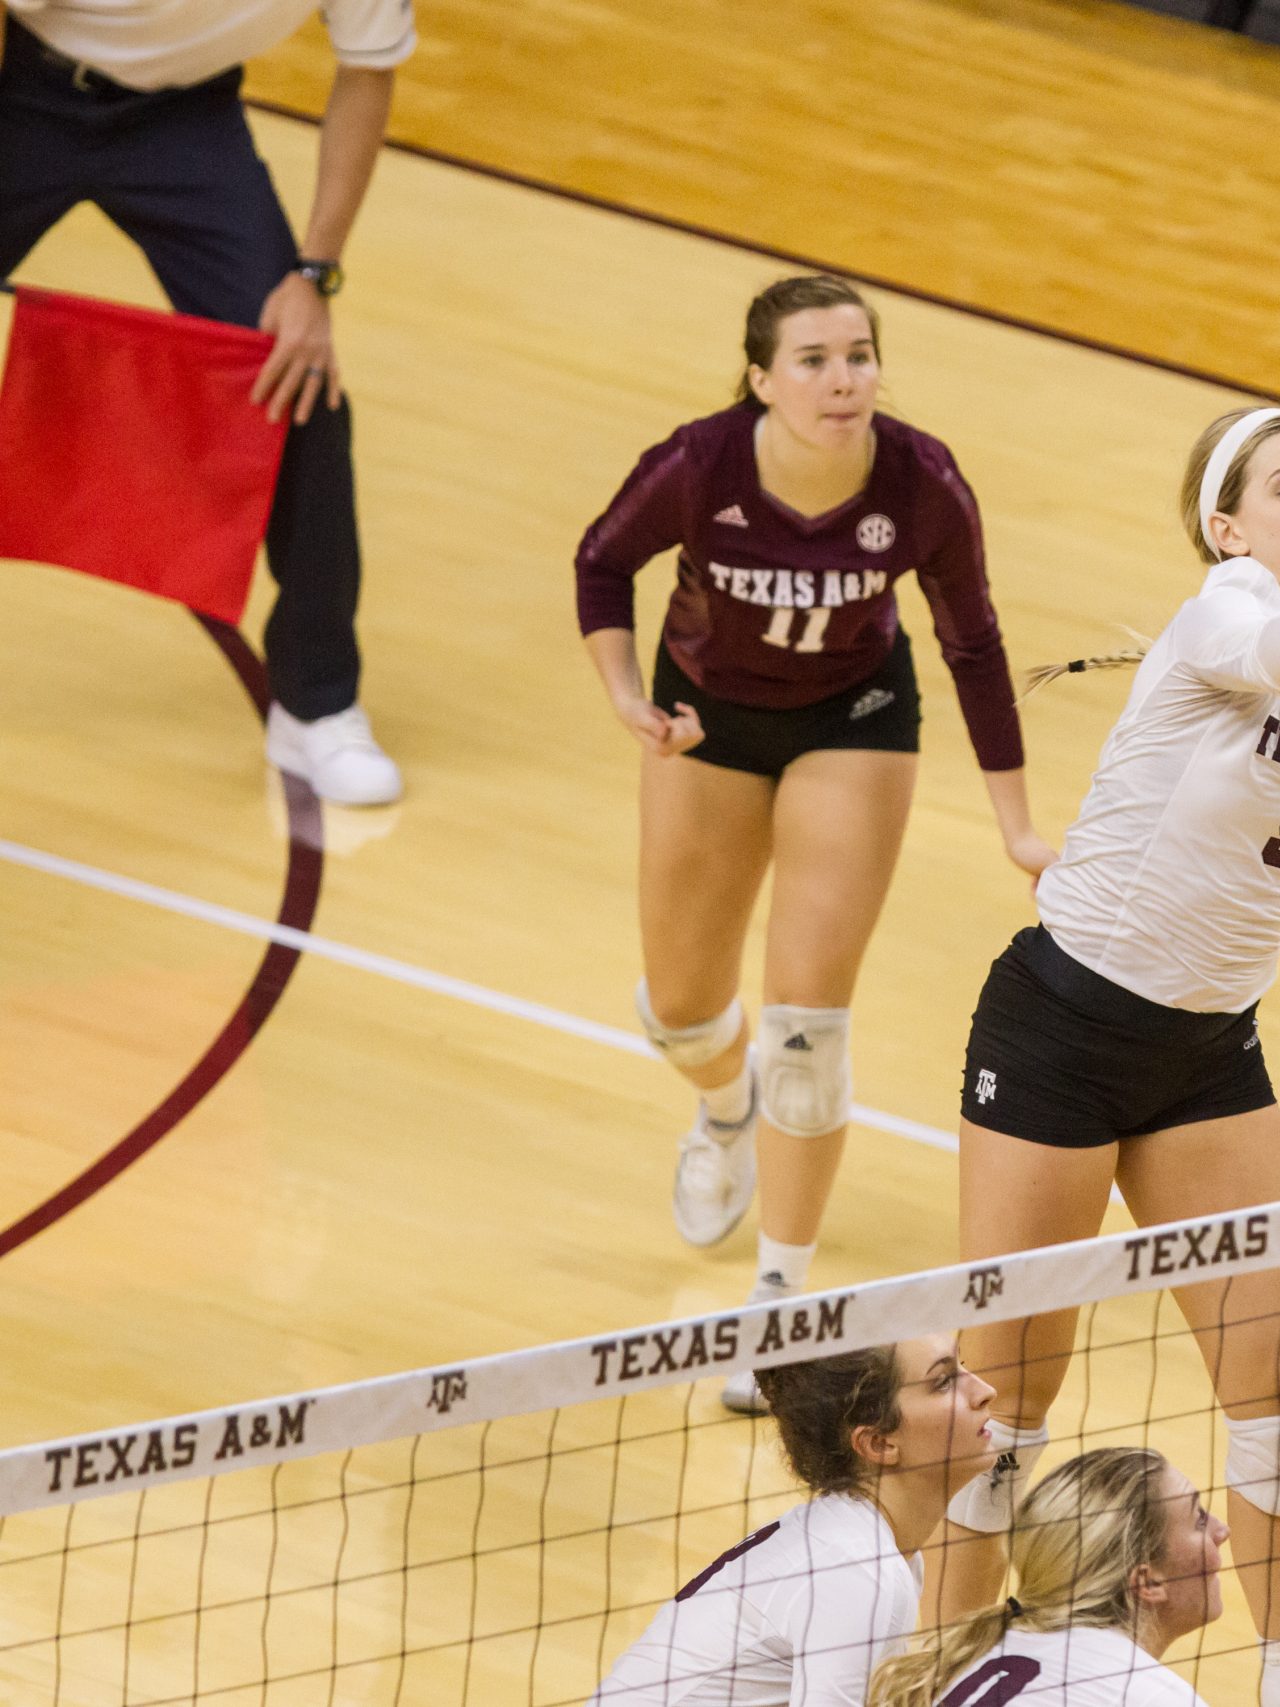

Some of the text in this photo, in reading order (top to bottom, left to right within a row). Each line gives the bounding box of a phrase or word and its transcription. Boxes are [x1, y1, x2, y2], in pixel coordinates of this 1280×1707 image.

[708, 561, 888, 609] TEXAS A&M
[761, 607, 832, 653] 11
[1124, 1215, 1270, 1281] TEXAS
[591, 1296, 849, 1386] TEXAS A&M
[45, 1401, 310, 1492] TEXAS A&M
